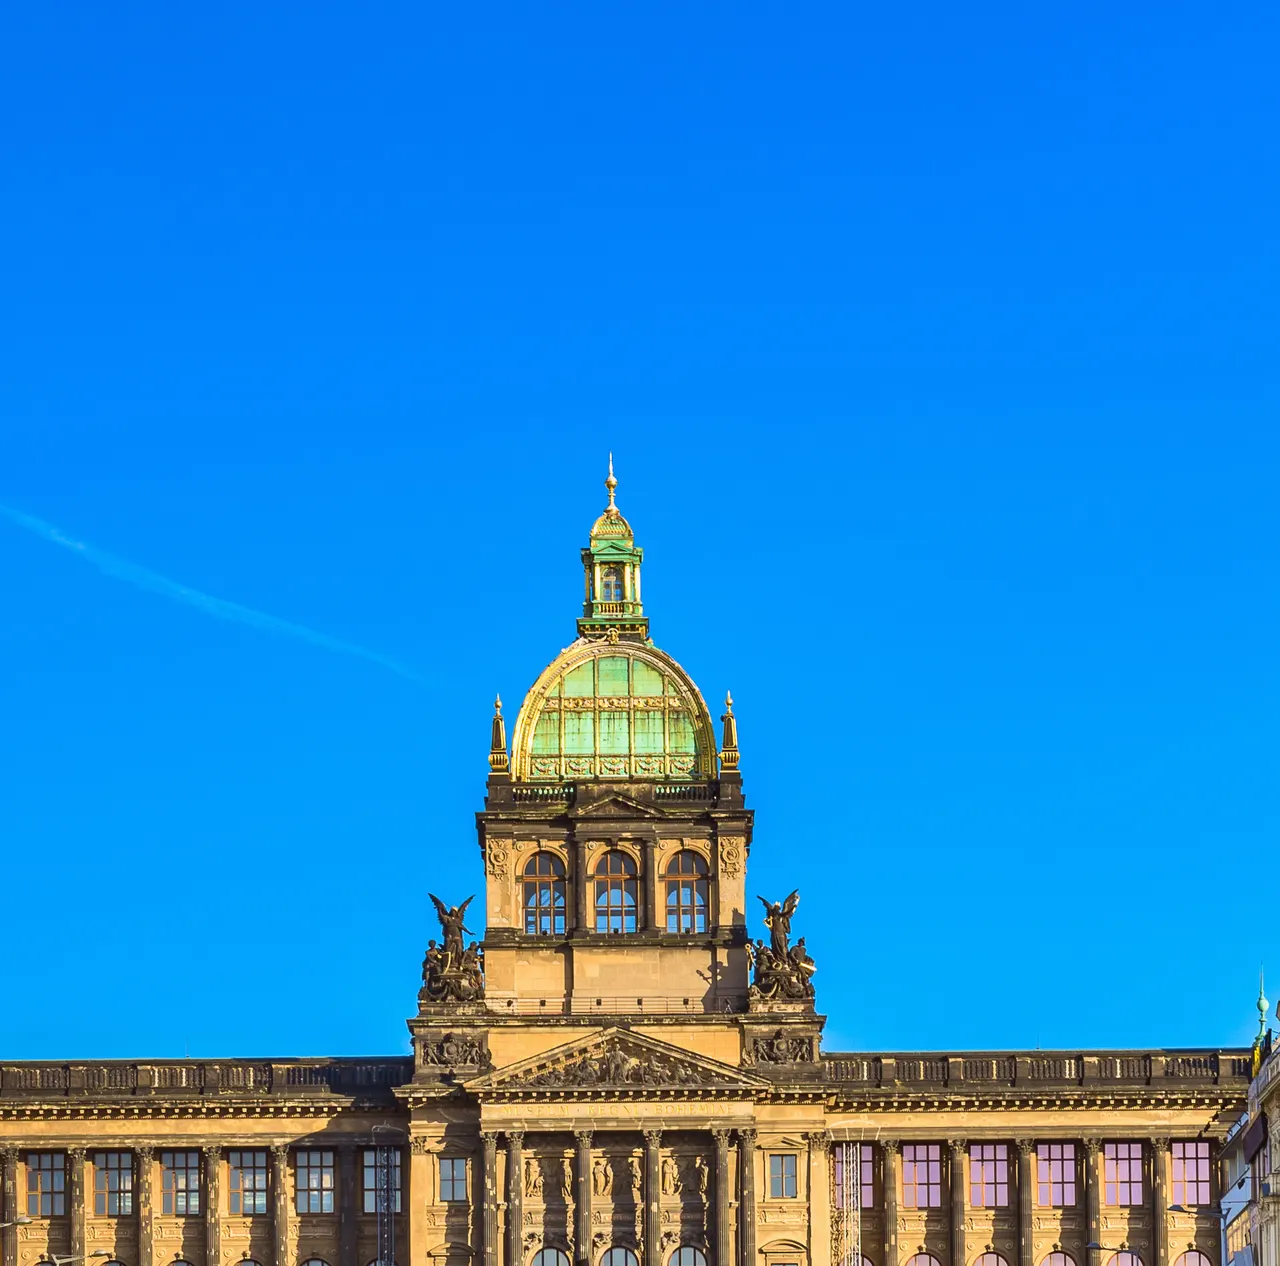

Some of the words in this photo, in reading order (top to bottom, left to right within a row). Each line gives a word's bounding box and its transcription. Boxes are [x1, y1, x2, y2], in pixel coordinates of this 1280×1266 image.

[503, 1105, 570, 1117] MUSEUM
[586, 1104, 640, 1117] REGNI
[654, 1103, 735, 1115] BOHEMIAE
